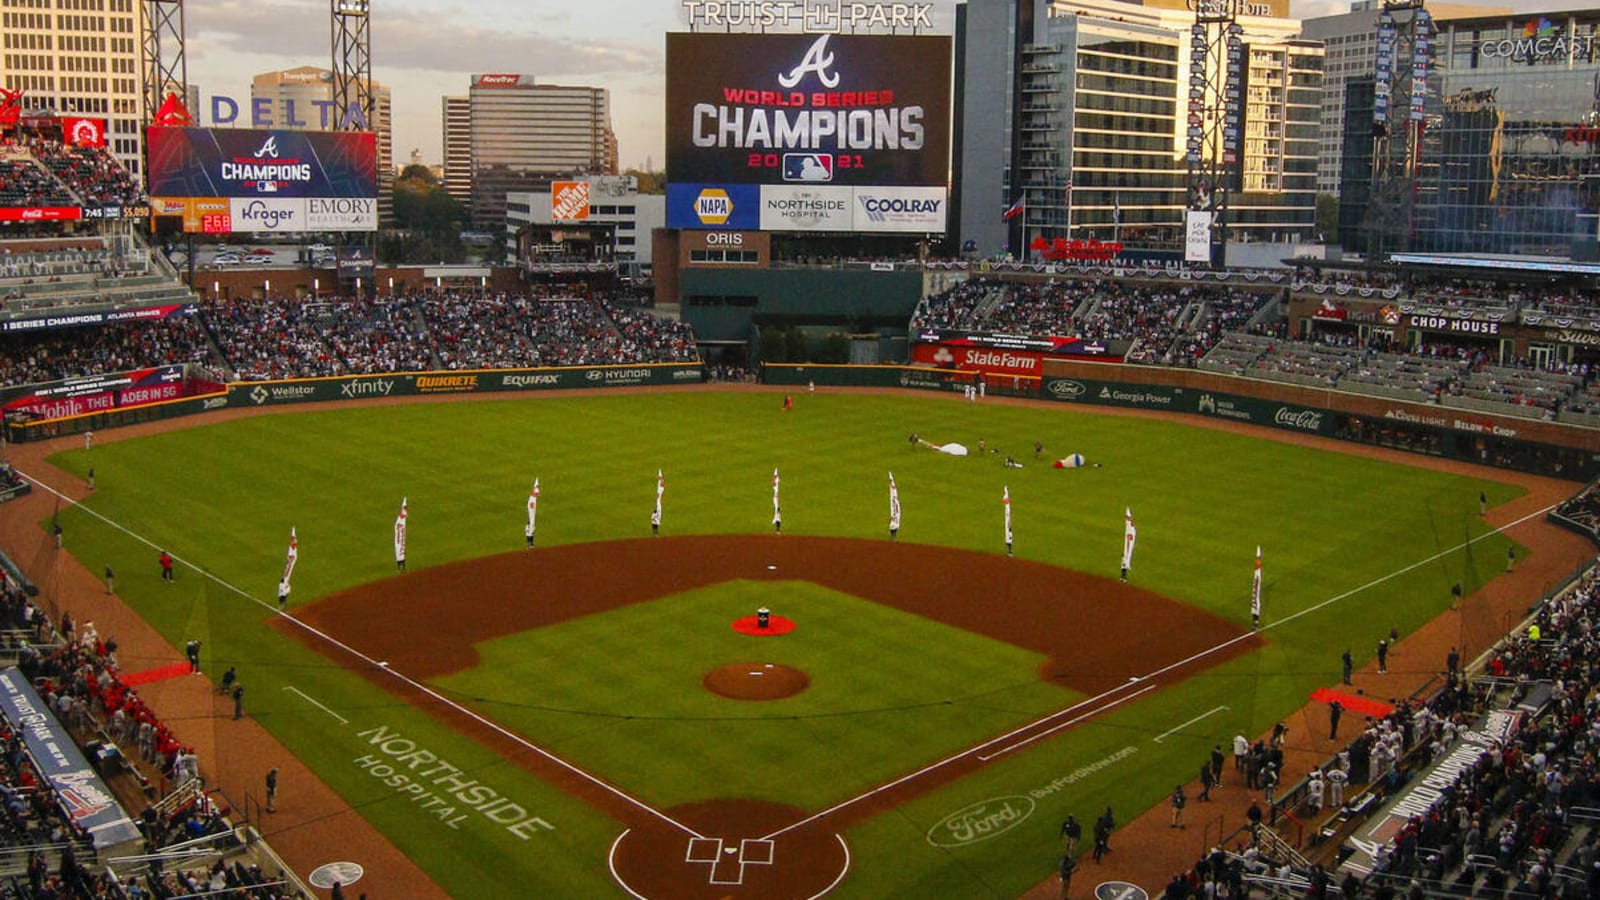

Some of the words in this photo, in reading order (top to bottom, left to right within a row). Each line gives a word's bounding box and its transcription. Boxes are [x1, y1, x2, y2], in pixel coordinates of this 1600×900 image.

[684, 1, 794, 27] TRUIST
[850, 2, 933, 28] PARK
[1480, 35, 1596, 58] COMCAST
[723, 87, 805, 107] WORLD
[811, 90, 895, 107] SERIES
[211, 95, 369, 129] DELTA
[692, 102, 925, 150] CHAMPIONS
[747, 154, 778, 167] 20
[837, 154, 864, 168] 21
[222, 162, 311, 181] CHAMPIONS
[310, 199, 373, 214] EMORY
[700, 198, 728, 216] NAPA
[768, 200, 845, 210] NORTHSIDE
[866, 199, 941, 213] COOLRAY
[204, 215, 230, 227] 268
[242, 200, 294, 229] Kroger
[706, 233, 743, 244] ORIS
[9, 319, 46, 331] SERIES
[47, 314, 102, 327] CHAMPIONS
[107, 310, 135, 320] ATLANTA
[1411, 316, 1447, 329] CHOP
[1451, 320, 1498, 334] HOUSE
[416, 375, 478, 388] QUIKRETE
[502, 374, 560, 387] EQUIFAX
[605, 369, 651, 379] HYUNDAI
[86, 396, 106, 409] THE
[150, 388, 162, 400] IN
[163, 385, 177, 398] 5G
[271, 385, 315, 396] Wellstar
[341, 378, 395, 398] xfinity
[1054, 382, 1078, 394] Ford
[1112, 390, 1142, 402] Georgia
[1146, 393, 1171, 404] Power
[354, 754, 471, 830] HOSPITAL
[357, 725, 555, 841] NORTHSIDE
[946, 802, 1022, 842] Ford
